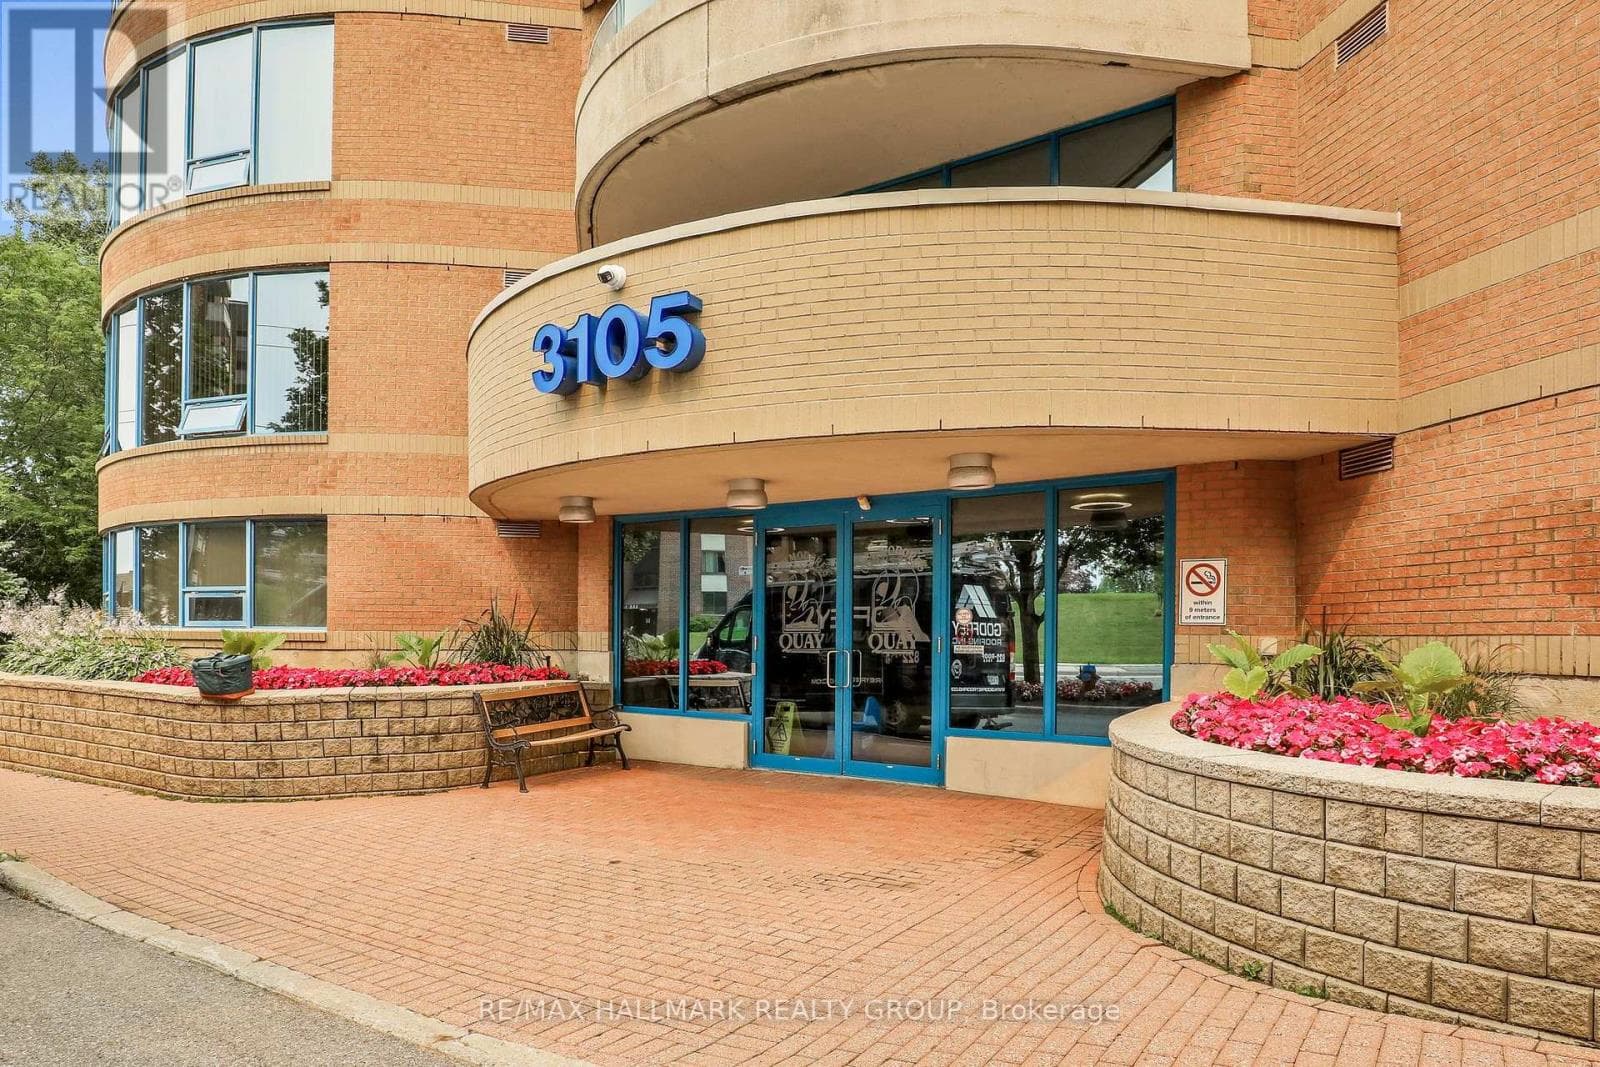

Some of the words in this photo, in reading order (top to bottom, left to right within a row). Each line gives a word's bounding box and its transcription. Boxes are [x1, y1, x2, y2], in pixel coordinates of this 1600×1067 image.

[532, 290, 706, 396] 3105
[779, 633, 825, 652] QUAY
[868, 633, 917, 653] QUAY
